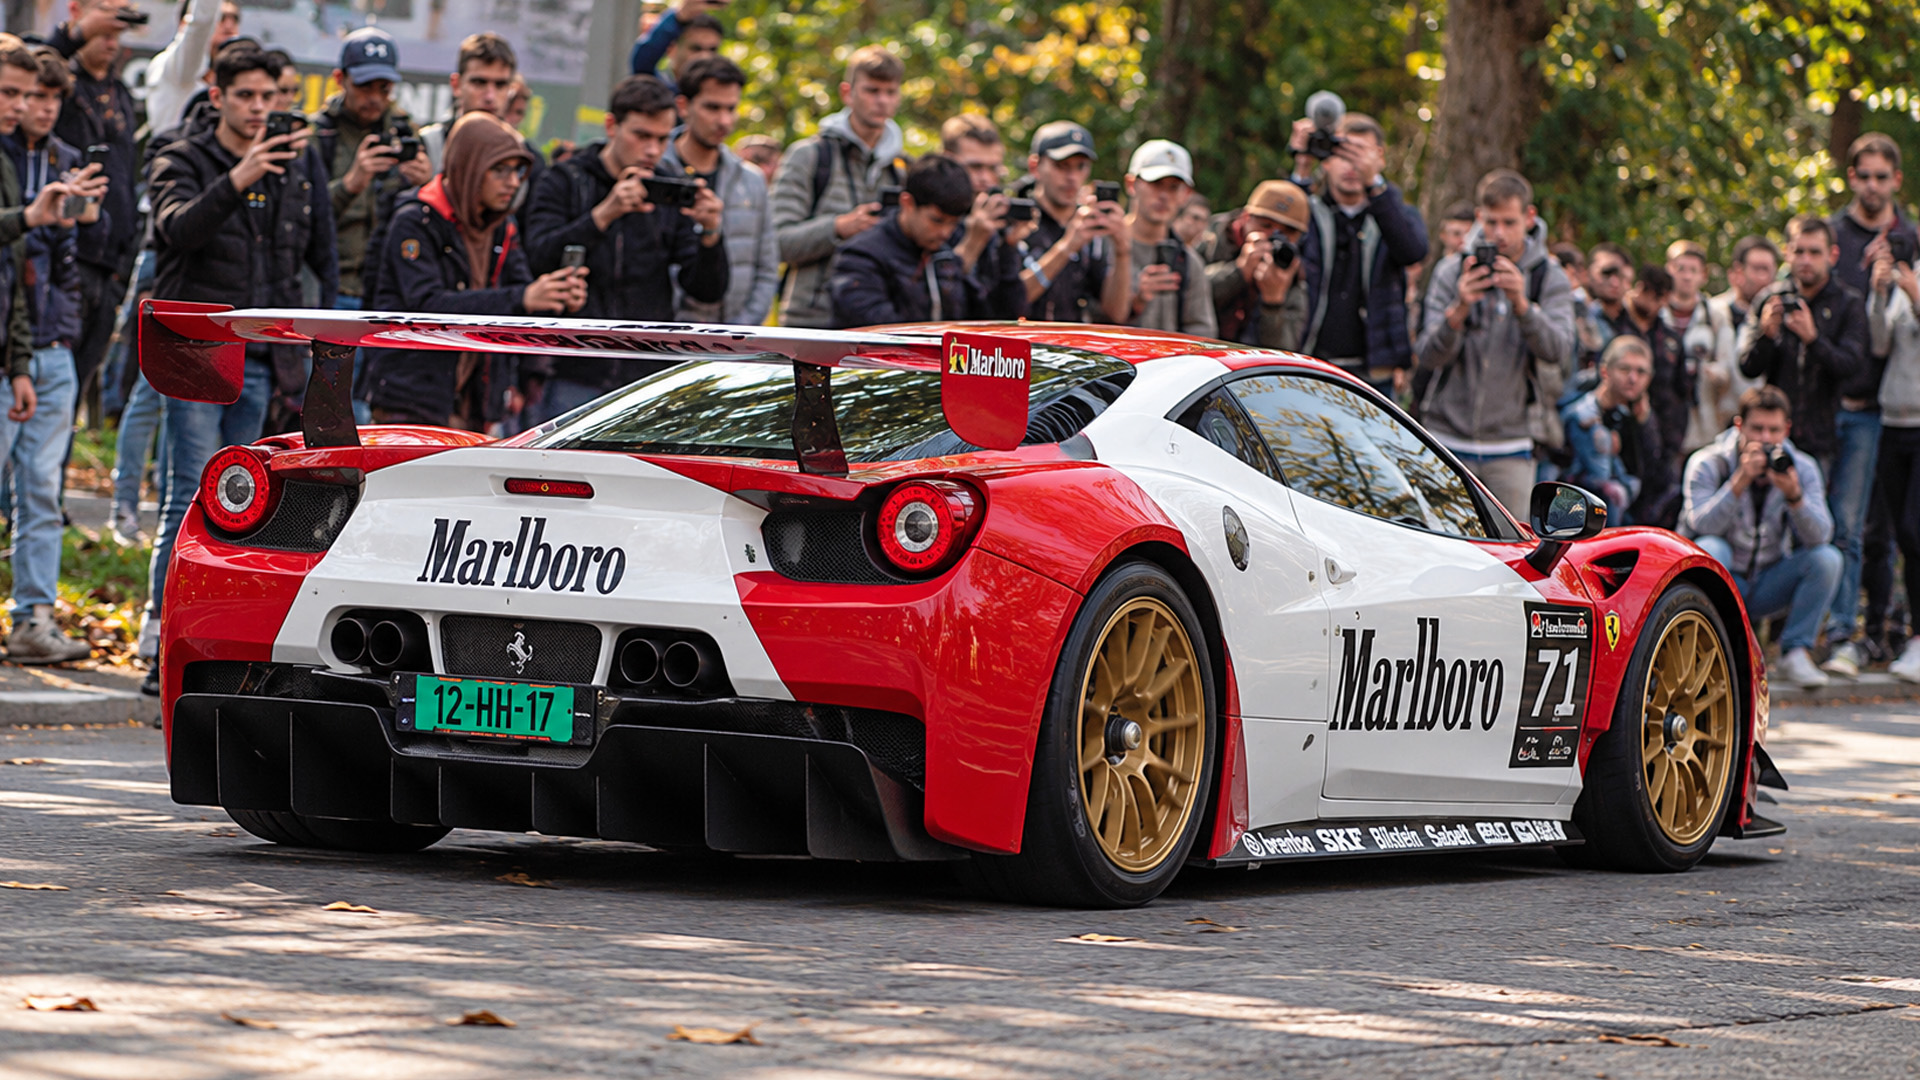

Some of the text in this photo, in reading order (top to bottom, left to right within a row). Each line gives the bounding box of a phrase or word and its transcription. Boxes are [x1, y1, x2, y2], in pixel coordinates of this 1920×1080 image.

[969, 346, 1026, 380] Marlboro
[416, 516, 627, 595] Marlboro
[1328, 616, 1504, 732] Marlboro
[1530, 646, 1580, 718] 71
[433, 684, 555, 732] 12-HH-17
[1315, 827, 1367, 852] SKF
